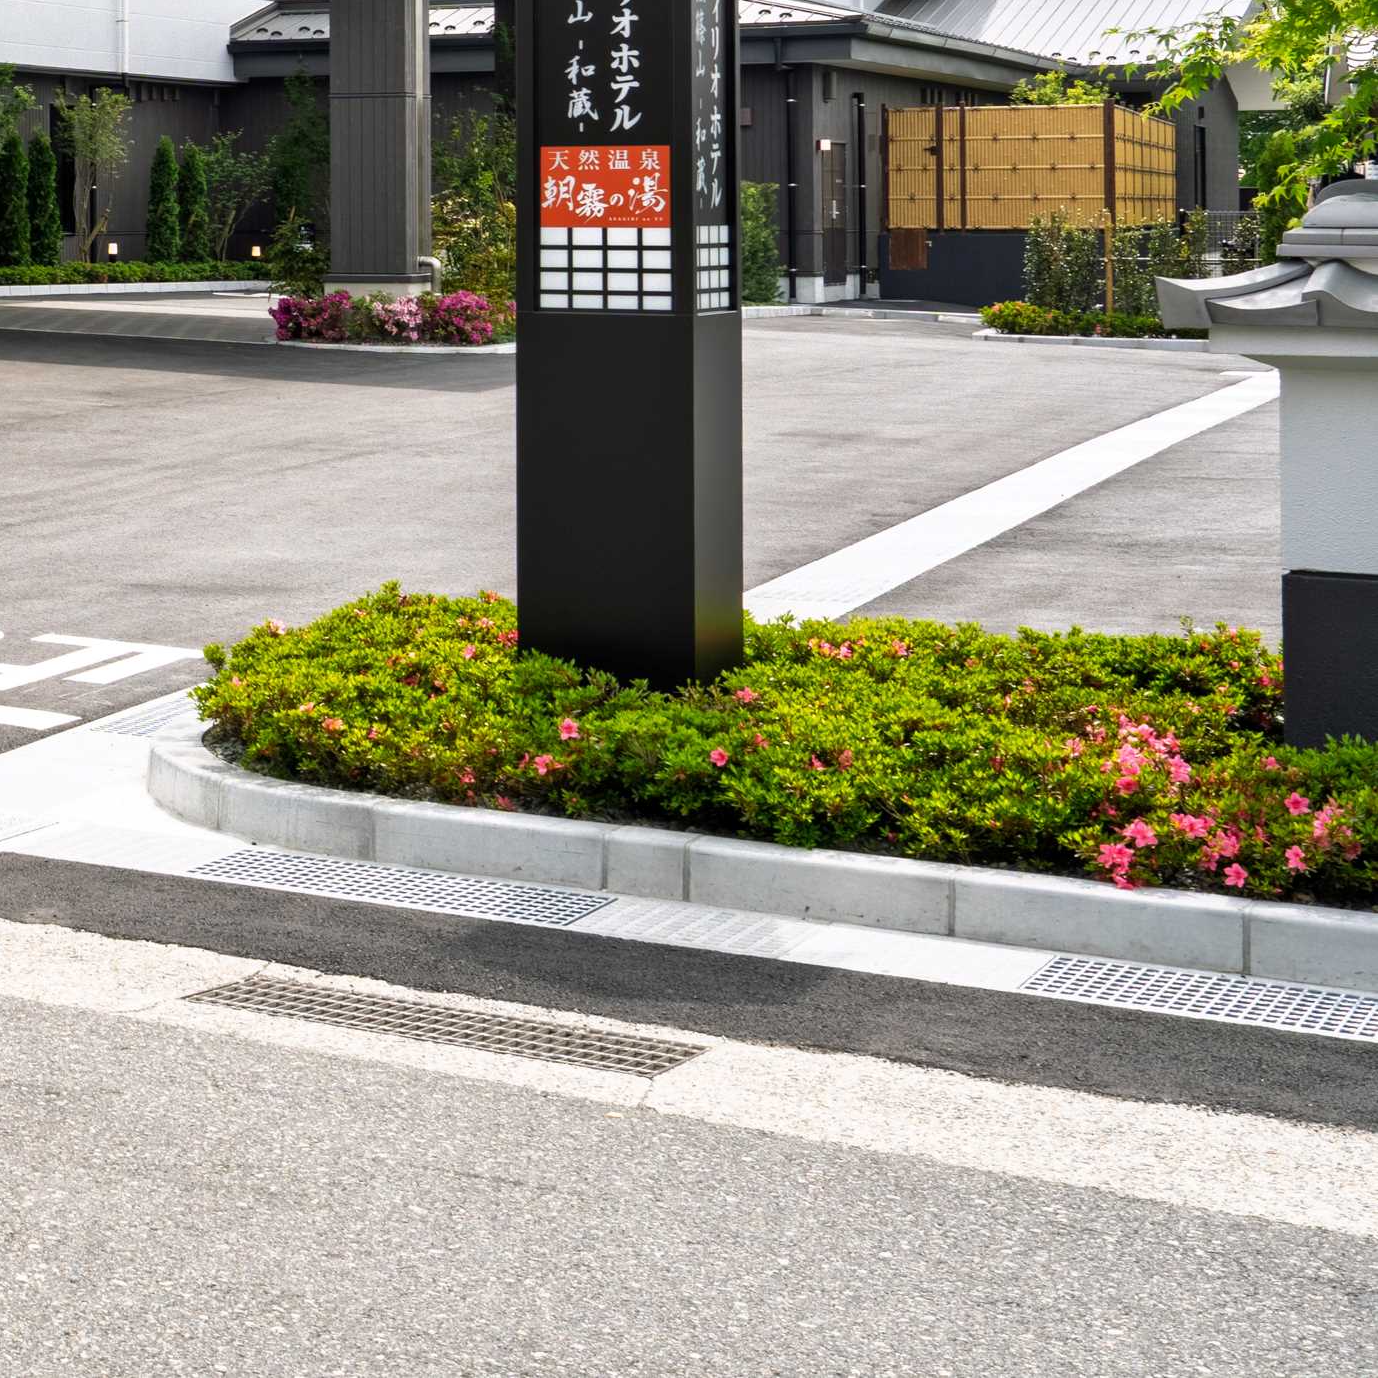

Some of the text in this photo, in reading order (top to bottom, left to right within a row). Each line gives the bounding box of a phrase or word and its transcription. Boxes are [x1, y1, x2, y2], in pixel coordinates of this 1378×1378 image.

[547, 148, 661, 171] 天然温泉
[541, 172, 669, 223] 朝霧の湯
